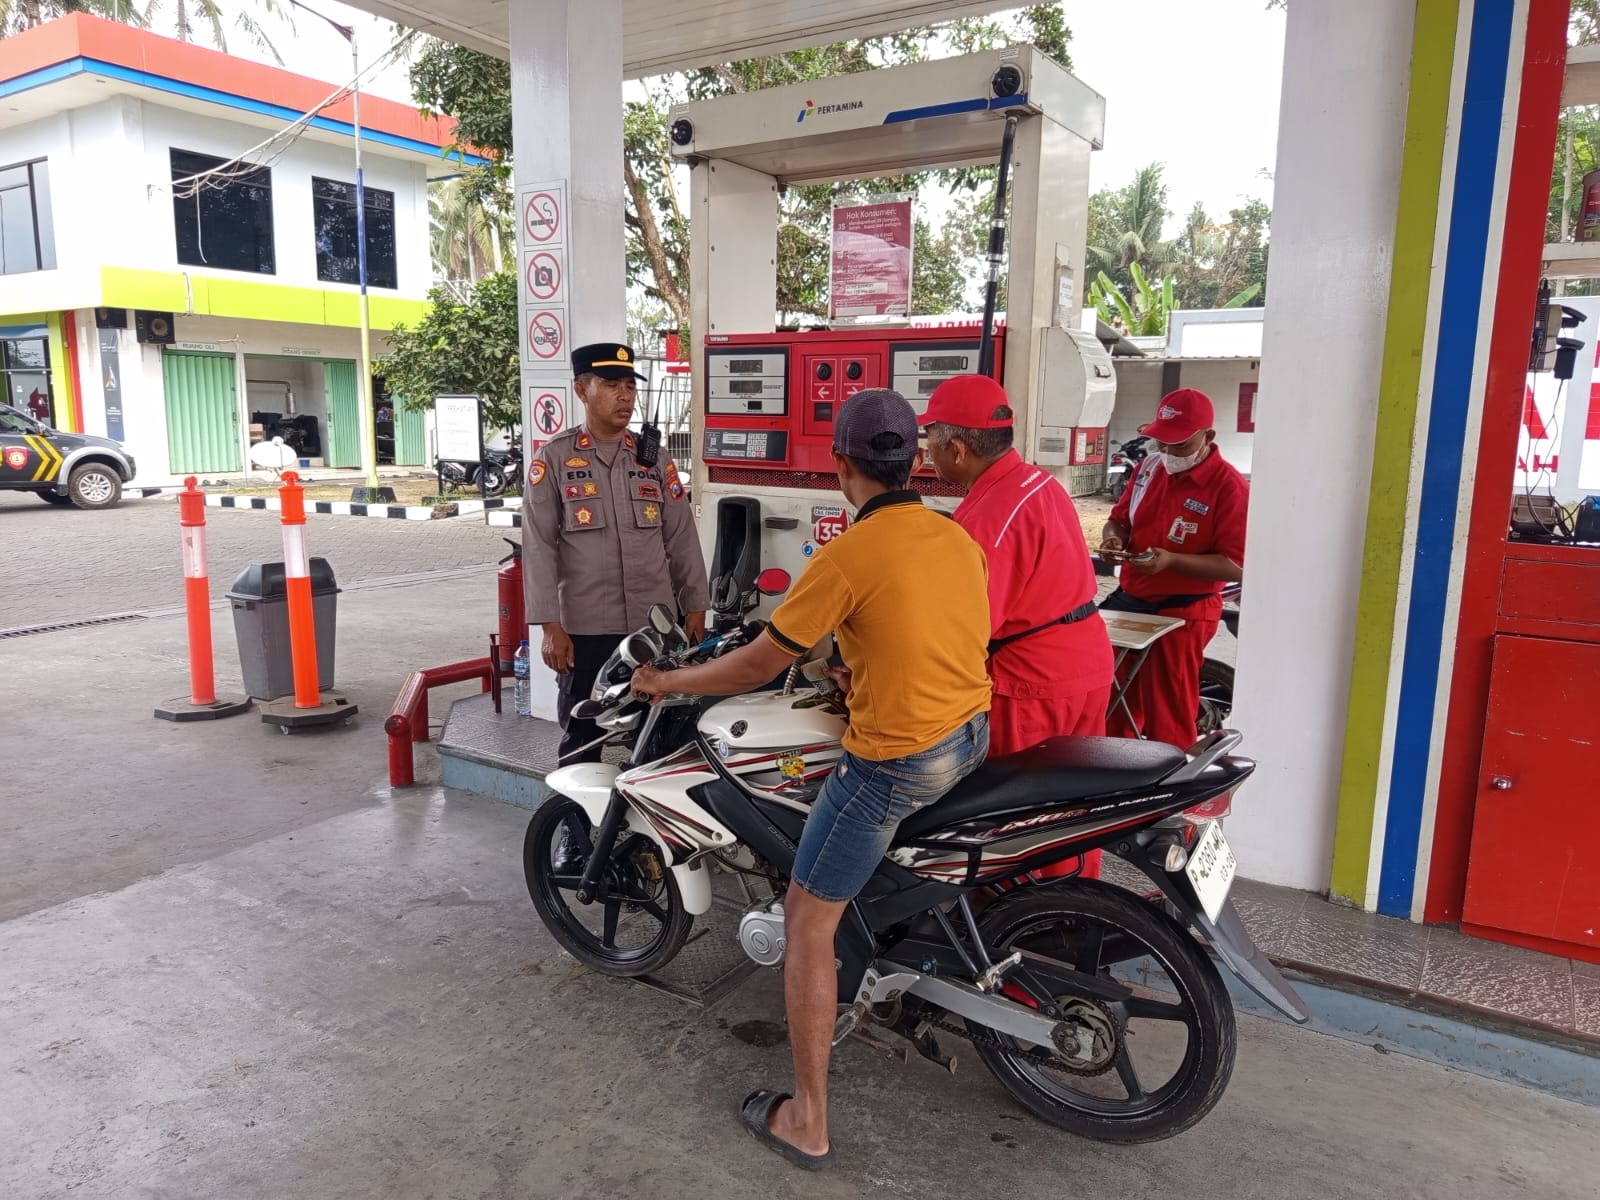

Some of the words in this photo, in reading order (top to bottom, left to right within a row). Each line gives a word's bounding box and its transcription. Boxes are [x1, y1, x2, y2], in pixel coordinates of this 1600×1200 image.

[817, 101, 864, 115] PERTAMINA
[846, 210, 859, 220] Hak
[567, 470, 593, 481] EDI
[815, 522, 843, 542] 135
[1190, 869, 1202, 892] P
